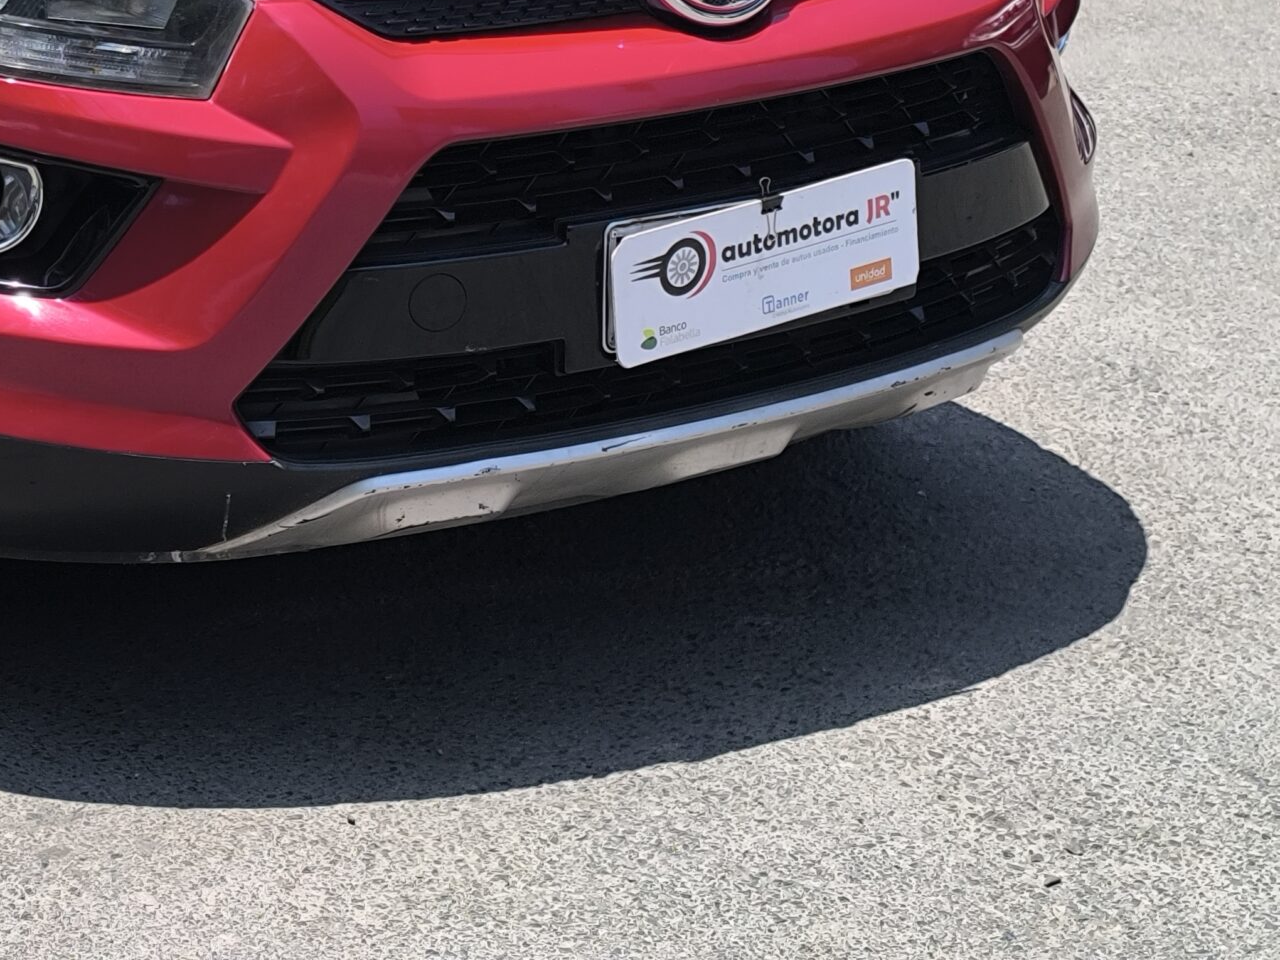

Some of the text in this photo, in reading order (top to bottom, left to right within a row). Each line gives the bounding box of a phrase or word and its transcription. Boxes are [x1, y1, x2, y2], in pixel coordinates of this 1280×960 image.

[720, 208, 860, 263] automotora
[721, 268, 752, 284] Compra
[780, 256, 790, 266] de
[812, 243, 840, 258] usados
[845, 226, 900, 248] Financiamiento
[854, 263, 886, 283] unidad
[763, 290, 810, 315] Tanner
[658, 321, 688, 337] Banco
